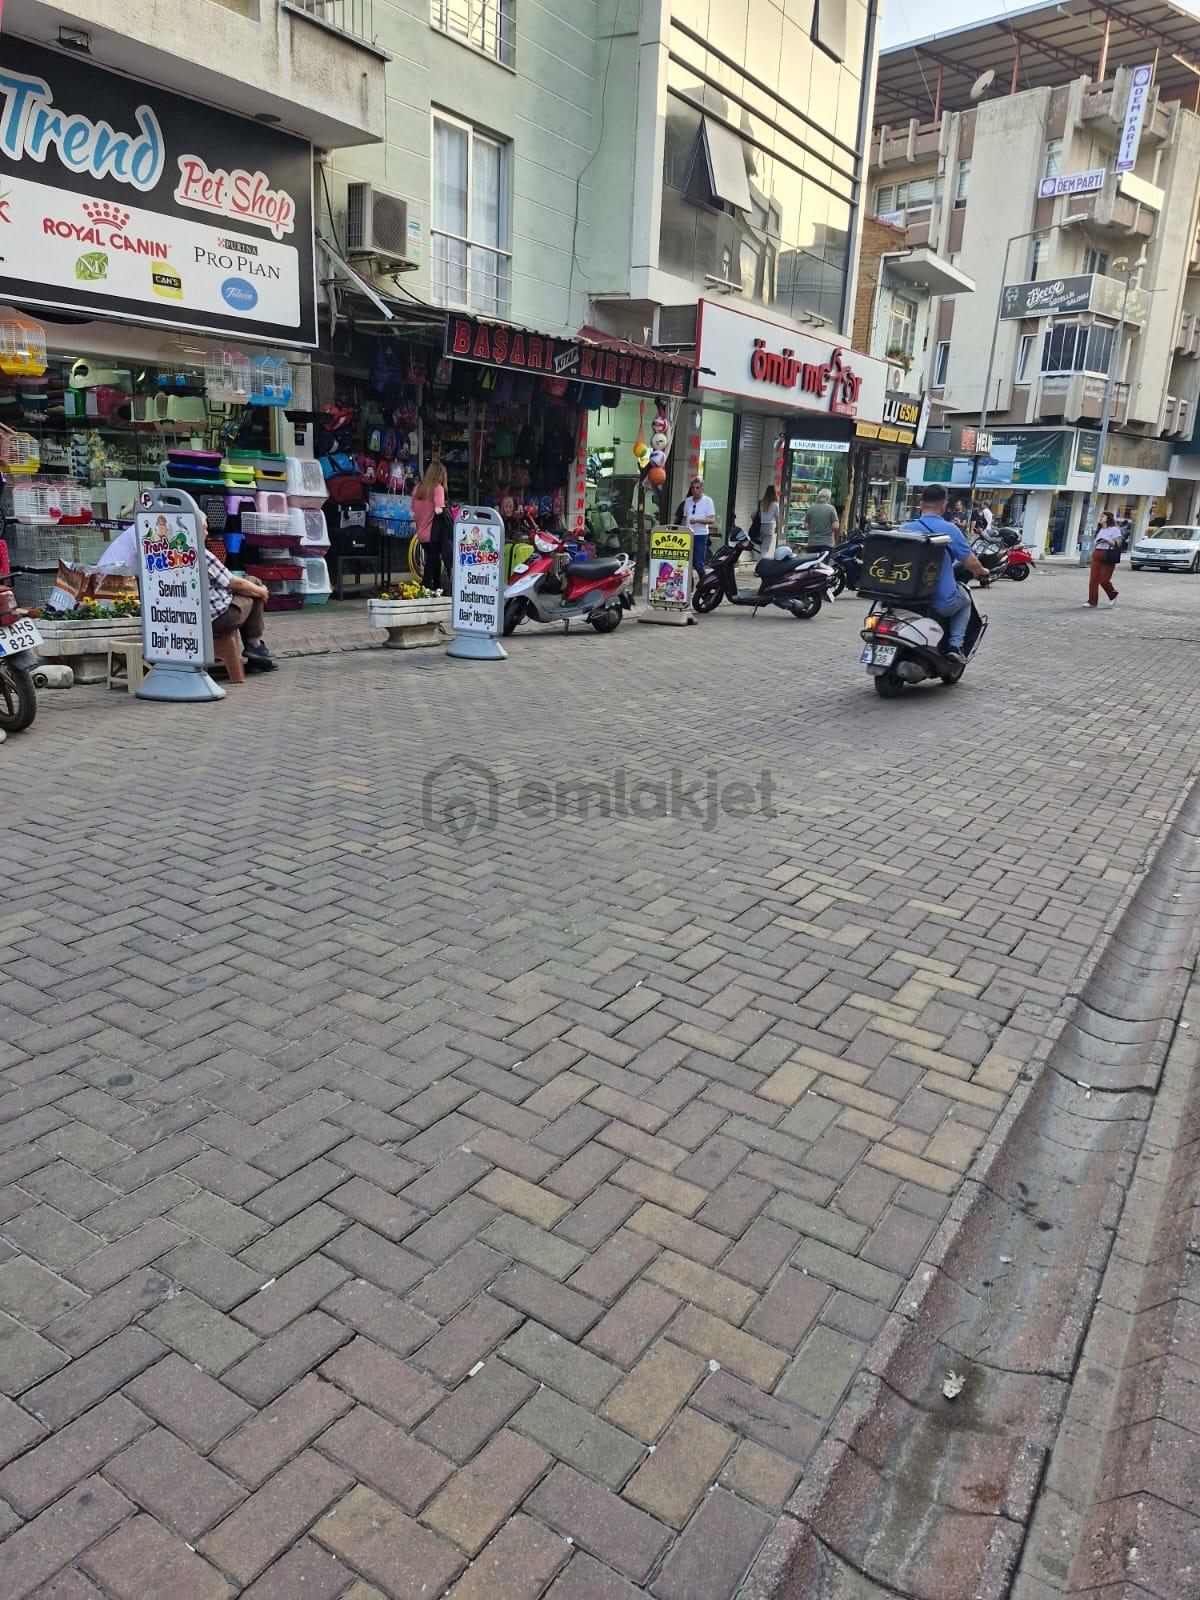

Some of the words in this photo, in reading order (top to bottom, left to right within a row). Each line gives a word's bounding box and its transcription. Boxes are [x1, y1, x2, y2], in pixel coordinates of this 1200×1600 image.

[1131, 88, 1143, 112] DEM
[0, 74, 160, 185] Trend
[1057, 179, 1075, 193] DEM
[181, 160, 224, 206] Pet
[230, 173, 291, 232] Shop
[43, 217, 106, 247] ROYAL
[109, 233, 168, 259] CANIN
[226, 241, 258, 255] PURINA
[194, 246, 233, 269] PRO
[237, 256, 281, 280] PLAN
[453, 320, 555, 370] BAŞARI
[900, 404, 919, 423] GSM
[144, 539, 168, 554] Trend
[159, 579, 187, 598] Sevimli
[467, 572, 490, 586] Sevimli
[151, 605, 197, 625] Dostlarınıza
[459, 608, 472, 622] Dair
[8, 620, 34, 636] AHS
[10, 634, 35, 650] 823
[152, 631, 169, 649] Dair
